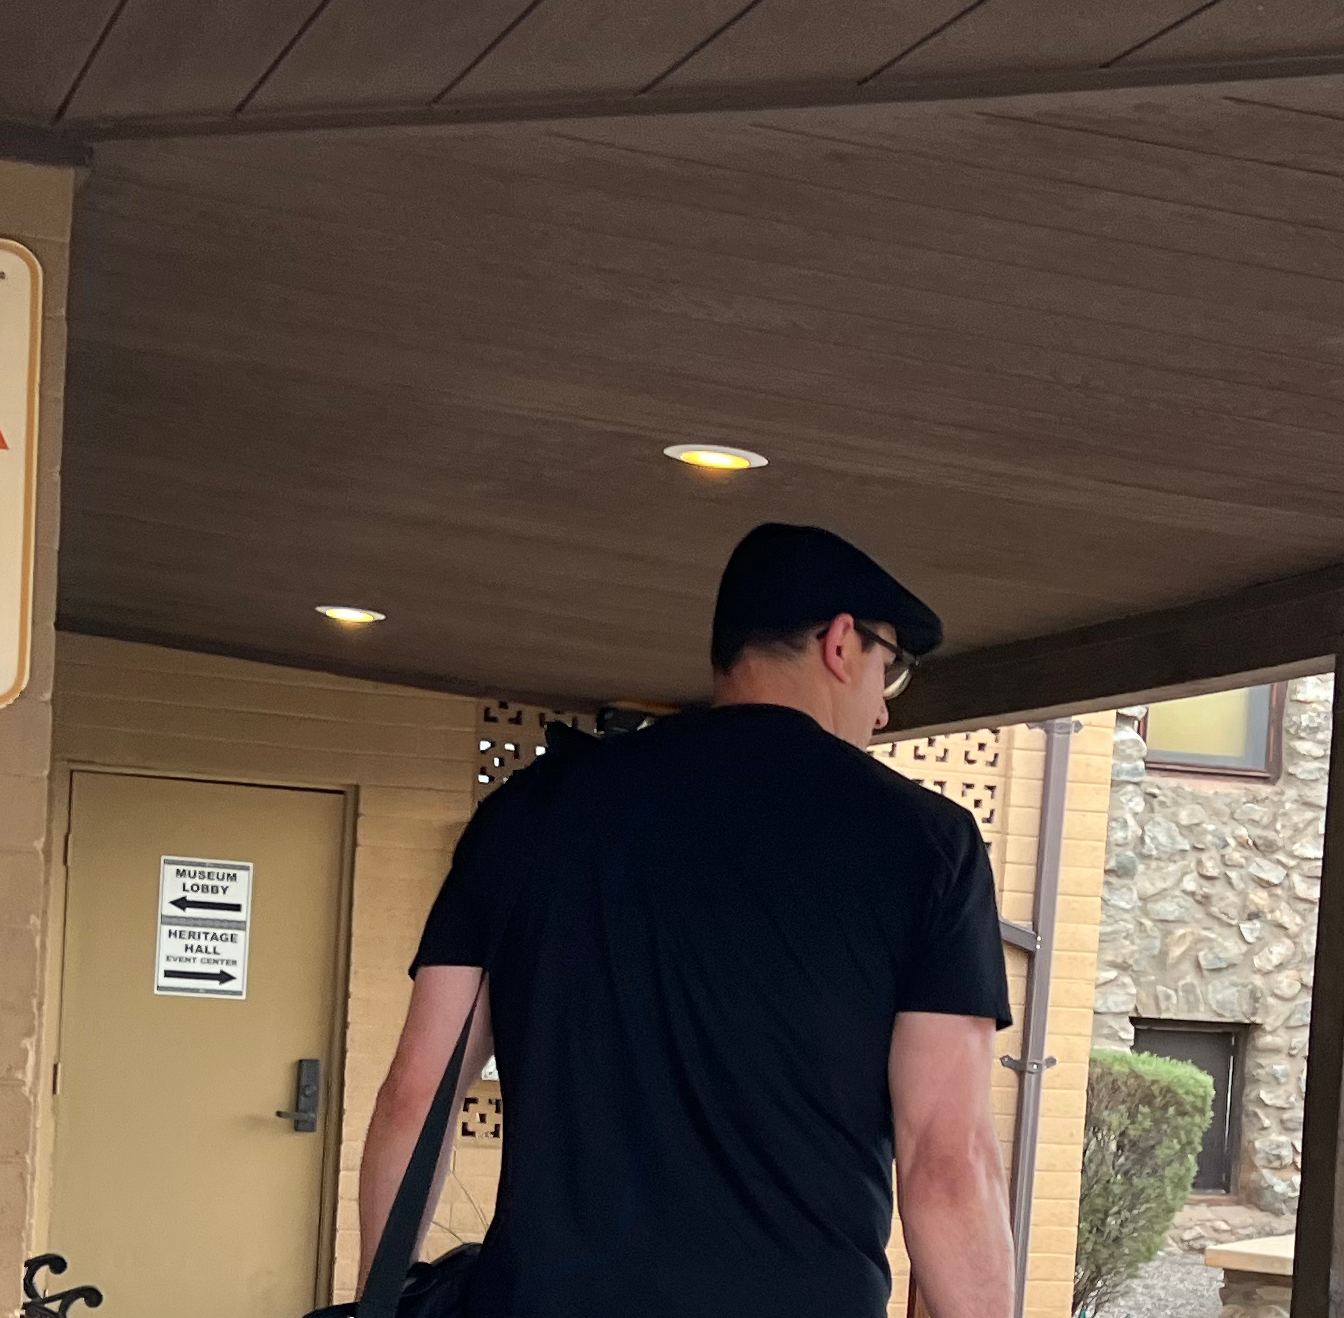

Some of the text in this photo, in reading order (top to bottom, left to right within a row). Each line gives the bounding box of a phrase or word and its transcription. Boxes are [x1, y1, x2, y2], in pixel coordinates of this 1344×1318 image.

[176, 868, 238, 882] MUSEUM
[182, 882, 229, 895] LOBBY
[168, 929, 238, 943] HERITAGE
[185, 944, 221, 955] HALL
[166, 955, 237, 966] EVENT CENTER
